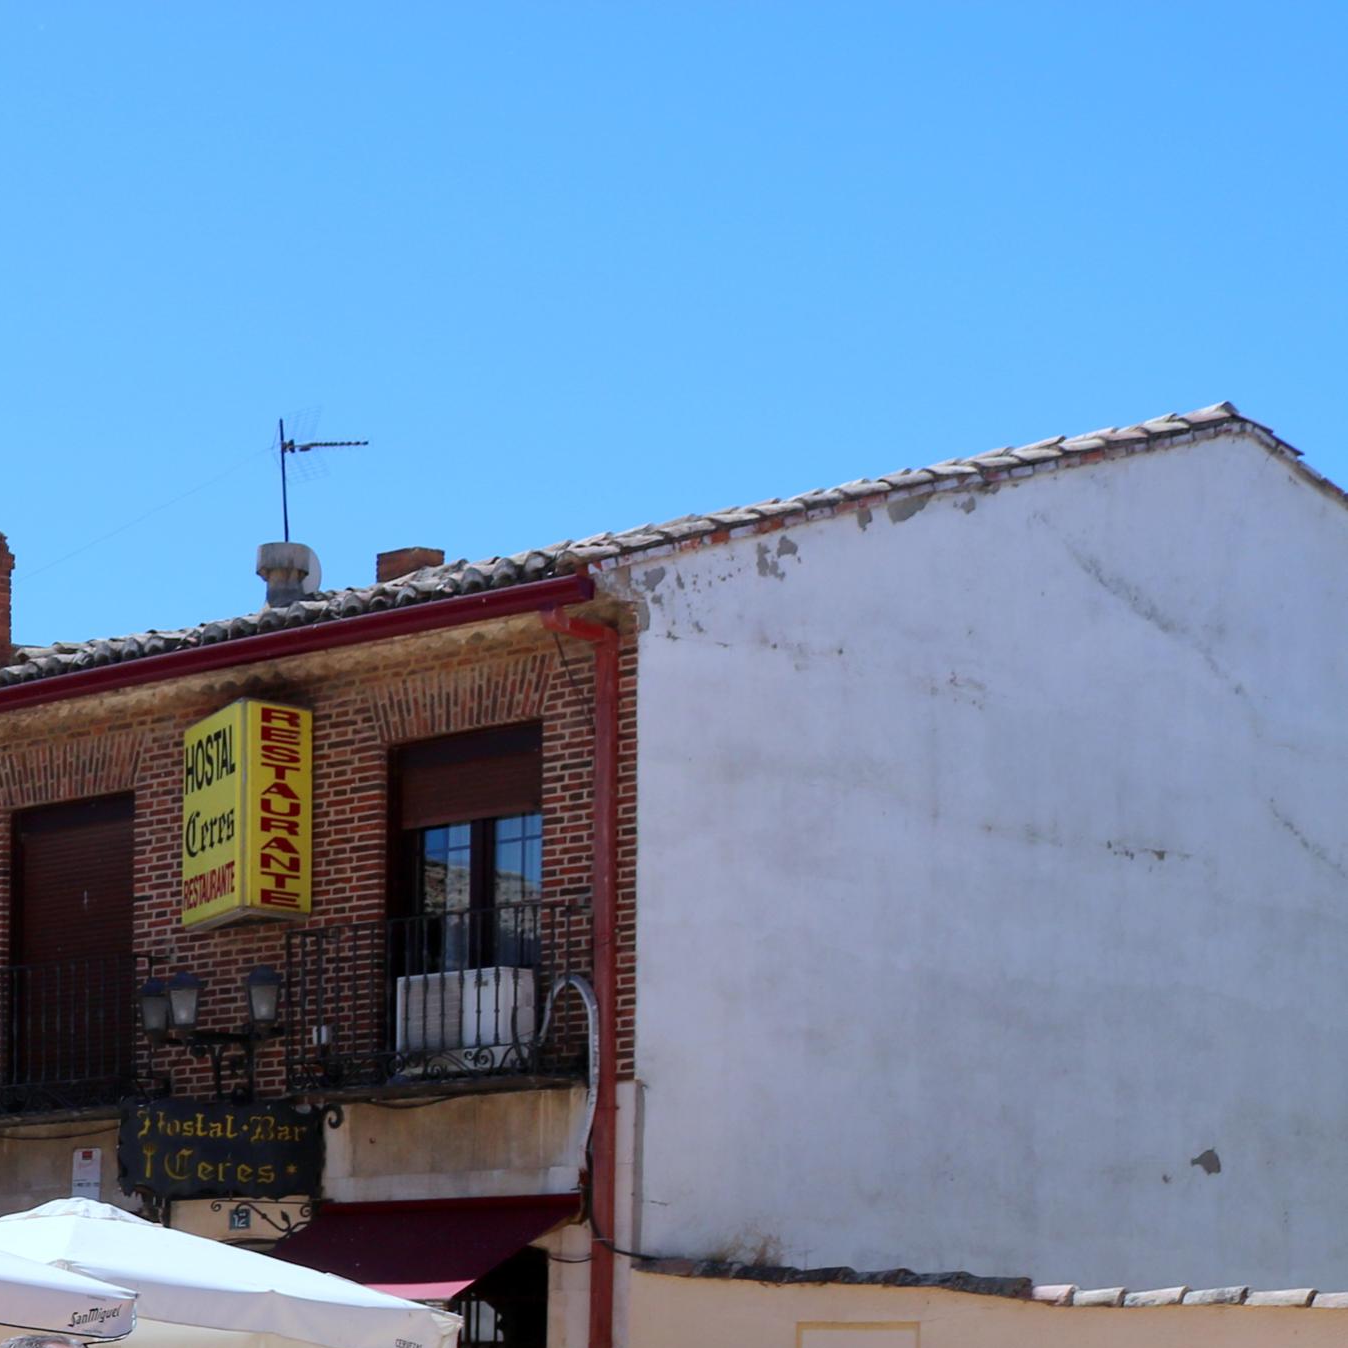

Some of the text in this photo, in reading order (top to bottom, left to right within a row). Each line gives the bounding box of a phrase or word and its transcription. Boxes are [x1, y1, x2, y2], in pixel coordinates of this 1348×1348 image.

[184, 724, 236, 796] HOSTAL
[185, 808, 235, 858] Ceres
[260, 706, 301, 909] RESTAURANTE
[183, 860, 235, 912] RESTAURANTE
[164, 1148, 276, 1184] Ceres
[233, 1212, 247, 1228] 12
